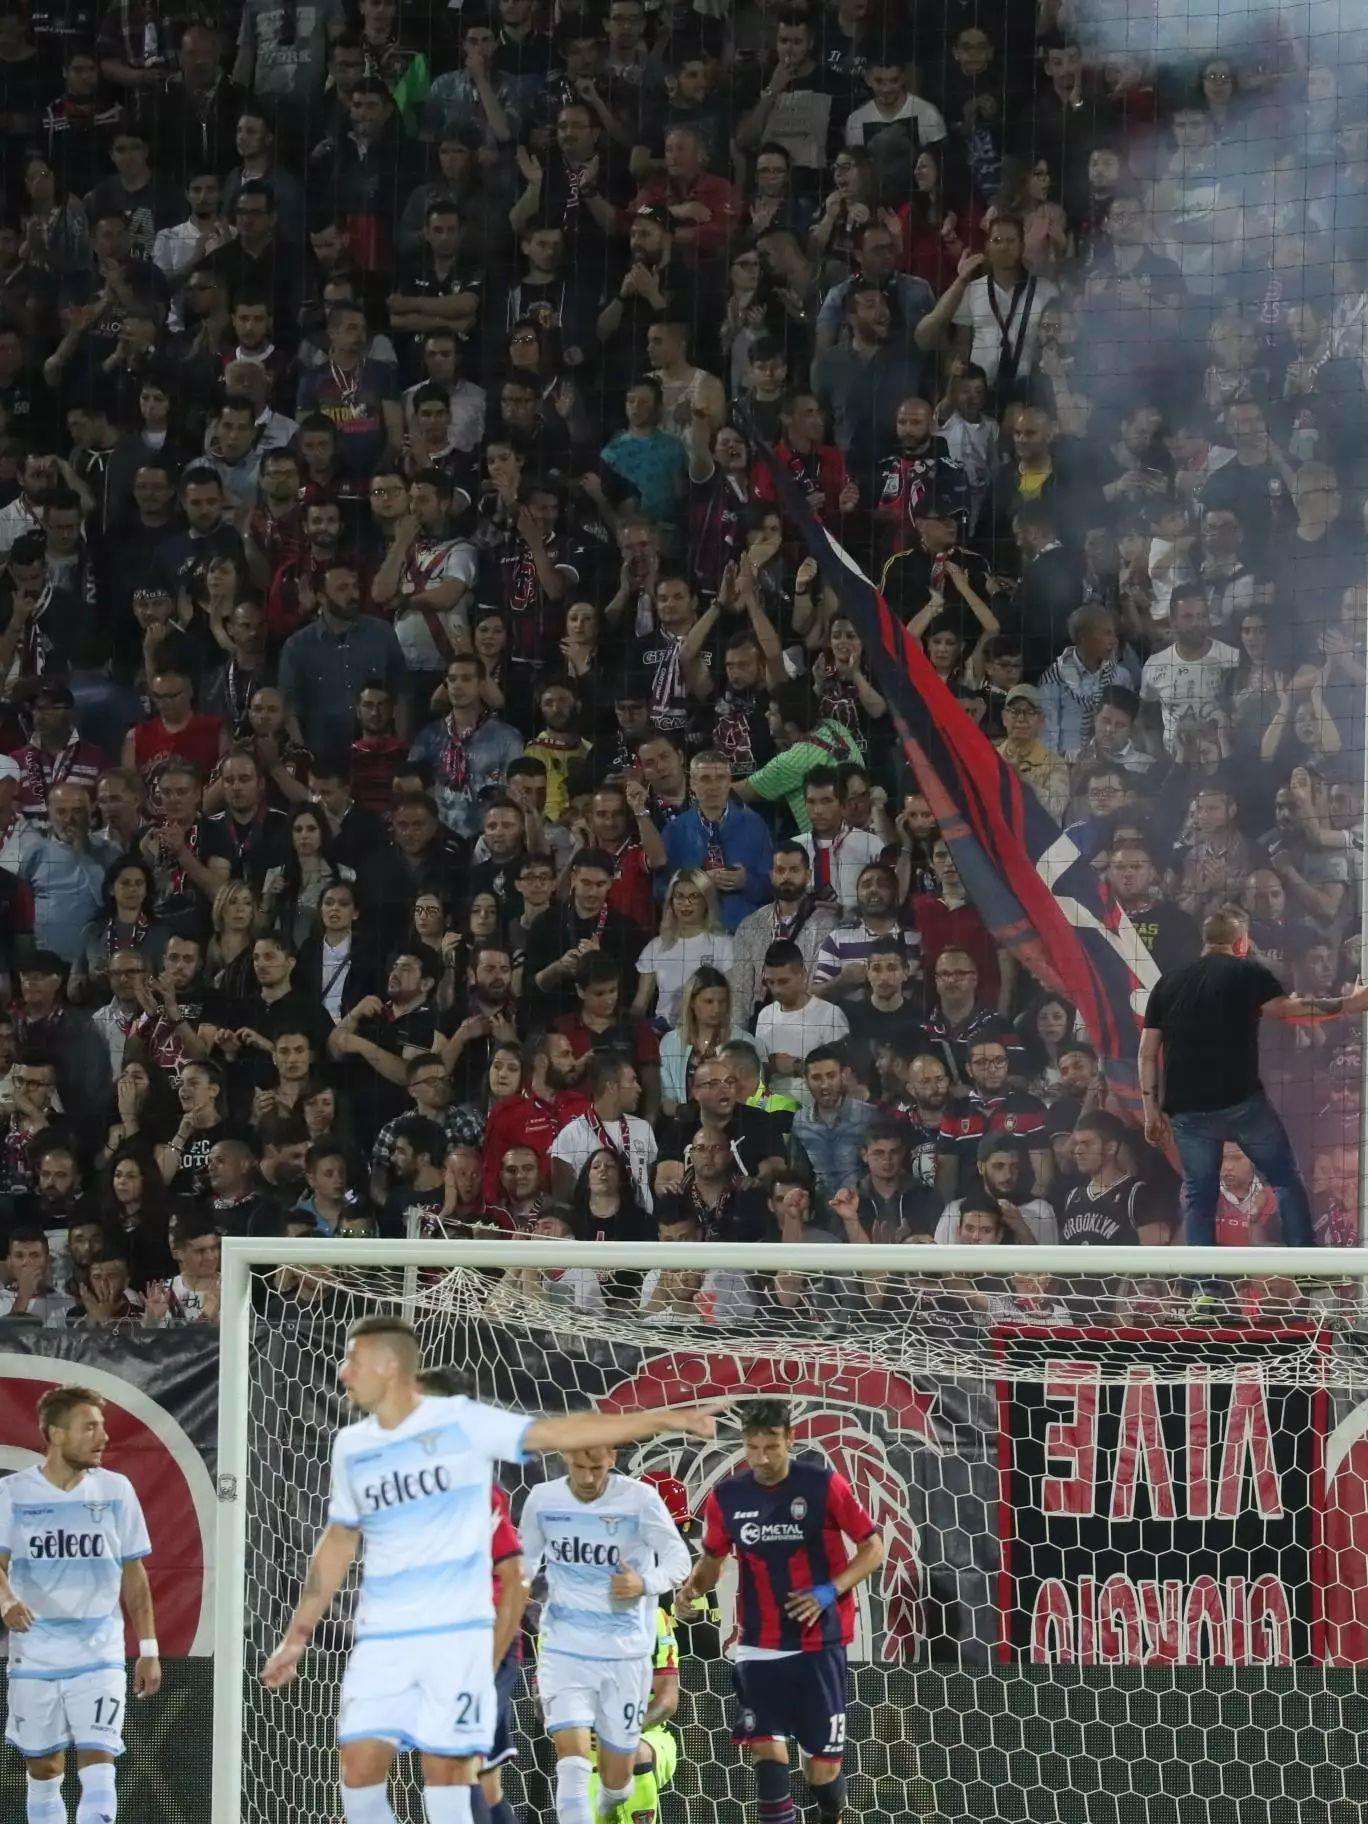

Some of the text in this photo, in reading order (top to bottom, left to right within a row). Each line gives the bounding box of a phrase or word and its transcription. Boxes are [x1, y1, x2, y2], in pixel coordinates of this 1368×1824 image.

[1062, 1212, 1121, 1241] BROOKLYN
[1040, 1360, 1285, 1522] VIVE
[761, 1524, 804, 1535] METAL
[94, 1696, 120, 1726] 17
[455, 1691, 481, 1725] 21
